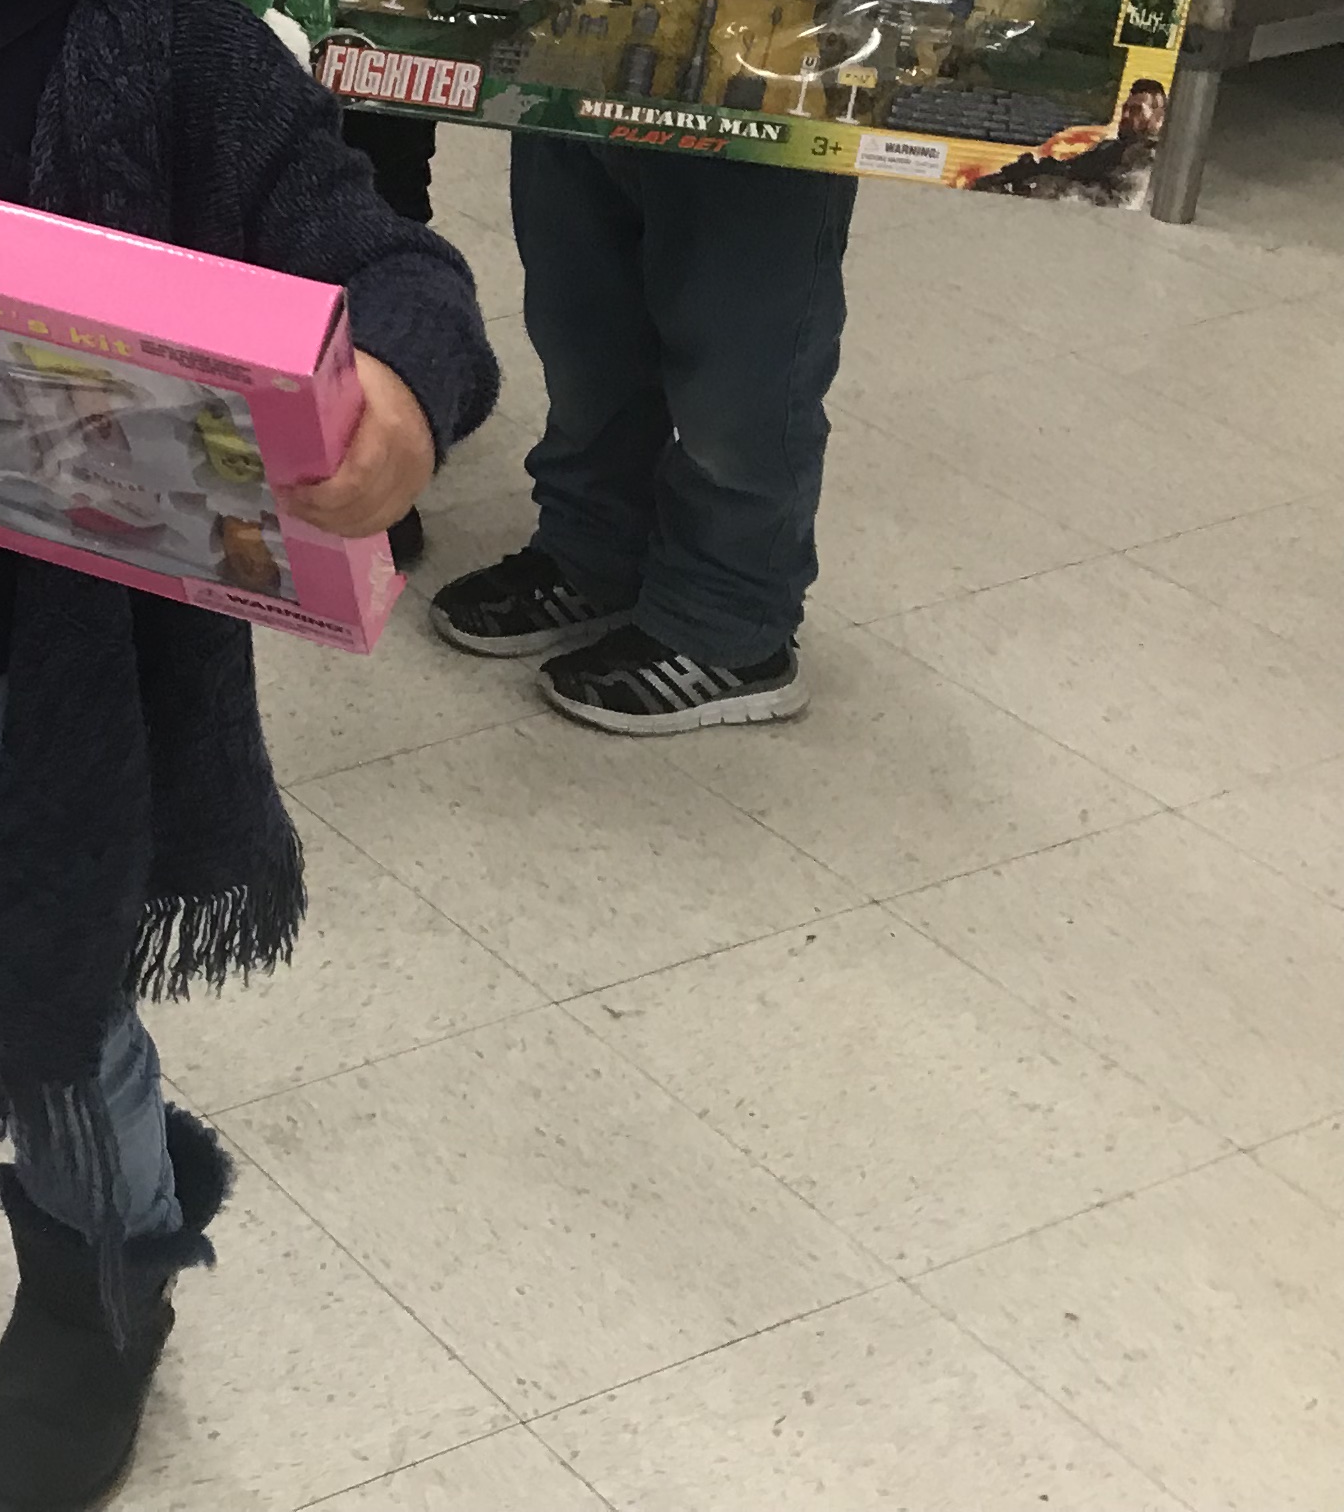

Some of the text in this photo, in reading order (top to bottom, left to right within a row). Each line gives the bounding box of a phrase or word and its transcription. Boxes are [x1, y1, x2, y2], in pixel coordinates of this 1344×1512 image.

[321, 44, 481, 108] FIGHTER
[578, 99, 782, 141] MILITARY MAN
[610, 125, 730, 153] PLAY SET
[811, 136, 842, 157] 3+
[885, 142, 941, 160] WARNING:
[69, 326, 132, 357] kit
